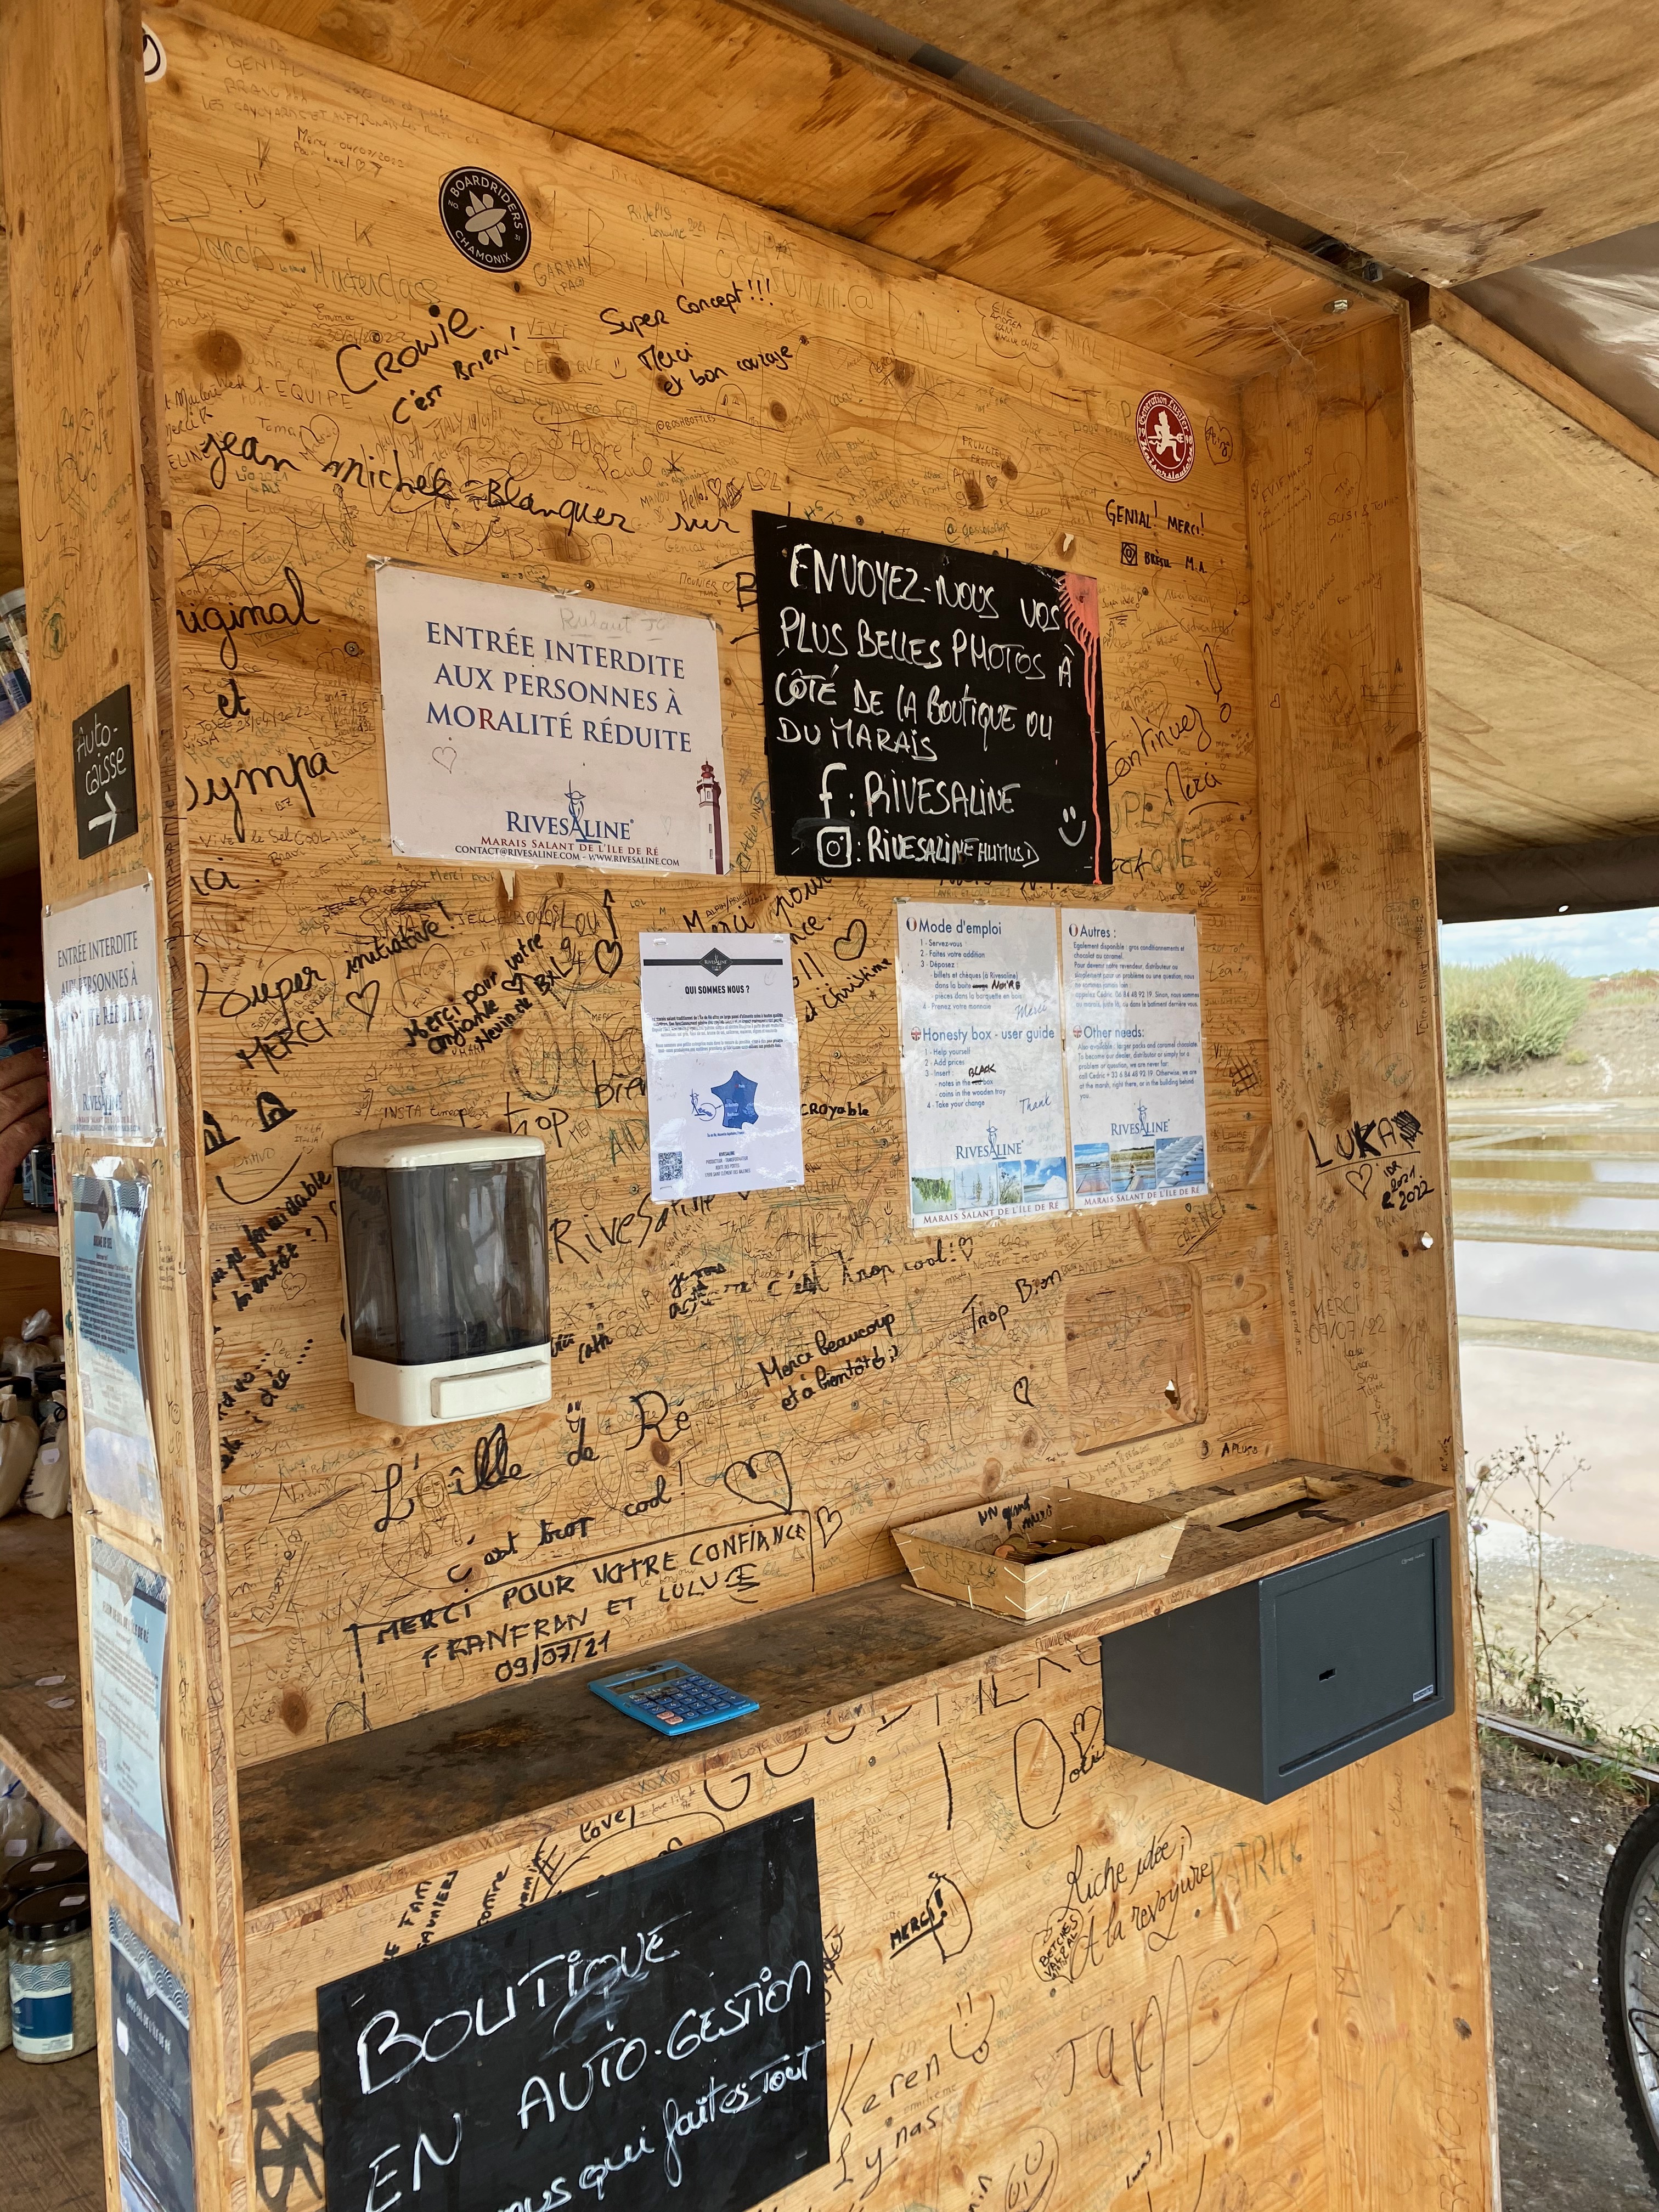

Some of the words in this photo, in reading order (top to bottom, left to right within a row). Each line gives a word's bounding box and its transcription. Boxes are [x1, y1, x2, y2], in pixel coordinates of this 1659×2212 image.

[450, 175, 523, 229] BOARDRIDERS
[455, 230, 511, 264] CHAMONIX
[691, 365, 728, 387] bon
[1138, 393, 1167, 426] Generation
[1167, 399, 1189, 432] Luzifer
[1138, 427, 1146, 437] 19
[1186, 435, 1193, 444] 98
[1140, 438, 1193, 479] Kaiserslautern
[1106, 499, 1158, 529] GENIAL!
[1020, 599, 1060, 631] VOS
[426, 620, 534, 658] ENTRÉE
[544, 638, 685, 680] INTERDITE
[779, 606, 849, 657] PLUS
[857, 619, 943, 669] BELLES
[952, 629, 1046, 680] PHOTOS
[1058, 644, 1075, 688] À
[434, 662, 494, 692] AUX
[504, 671, 658, 712] PERSONNES
[665, 688, 682, 715] À
[775, 664, 839, 706] CÔTÉ
[854, 679, 884, 715] DE
[896, 685, 918, 724] LA
[1026, 712, 1052, 741] OU
[426, 701, 573, 741] MORALITÉ
[583, 718, 692, 753] RÉDUITE
[776, 716, 821, 746] DU
[455, 845, 580, 861] CONTACT@RIVESALINE.COM
[588, 854, 680, 866] WWW.RIVESALINE.COM
[481, 836, 528, 849] MARAIS
[532, 838, 577, 851] SALANT
[579, 843, 596, 852] DE
[628, 847, 644, 855] DE
[646, 846, 659, 856] RÉ
[919, 918, 952, 933] Mode
[956, 919, 1002, 939] d'emploi
[1080, 924, 1110, 938] Autres
[58, 939, 87, 968] ENTRÉE
[89, 930, 138, 961] INTERDITE
[929, 939, 963, 948] Servez-vous
[929, 960, 955, 969] Déposez
[959, 972, 981, 981] chèques
[685, 986, 697, 995] QUI
[698, 985, 726, 994] SOMMES
[727, 985, 744, 994] NOUS
[935, 992, 953, 1002] pièces
[923, 1028, 968, 1045] Honesty
[972, 1025, 991, 1040] box
[1002, 1029, 1023, 1040] user
[1026, 1024, 1055, 1043] guide
[1084, 1025, 1112, 1038] Other
[1115, 1024, 1145, 1037] needs:
[933, 1048, 947, 1057] Help
[949, 1047, 971, 1057] yourself
[948, 1059, 965, 1068] prices
[968, 1063, 997, 1077] BLACK
[995, 1087, 1006, 1096] tray
[950, 1102, 963, 1110] your
[965, 1099, 985, 1109] change
[1084, 1197, 1114, 1206] MARAIS
[1116, 1192, 1144, 1203] SALANT
[1400, 1180, 1435, 1211] 2022
[923, 1214, 958, 1224] MARAIS
[962, 1208, 995, 1220] SALANT
[998, 1208, 1009, 1216] DE
[1035, 1204, 1046, 1212] DE
[503, 1575, 575, 1609] POUR
[690, 1524, 806, 1566] CONFIANCE
[607, 1595, 636, 1616] ET
[495, 1630, 611, 1683] 09/07/21
[366, 2112, 464, 2212] EN
[579, 2125, 655, 2200] qui
